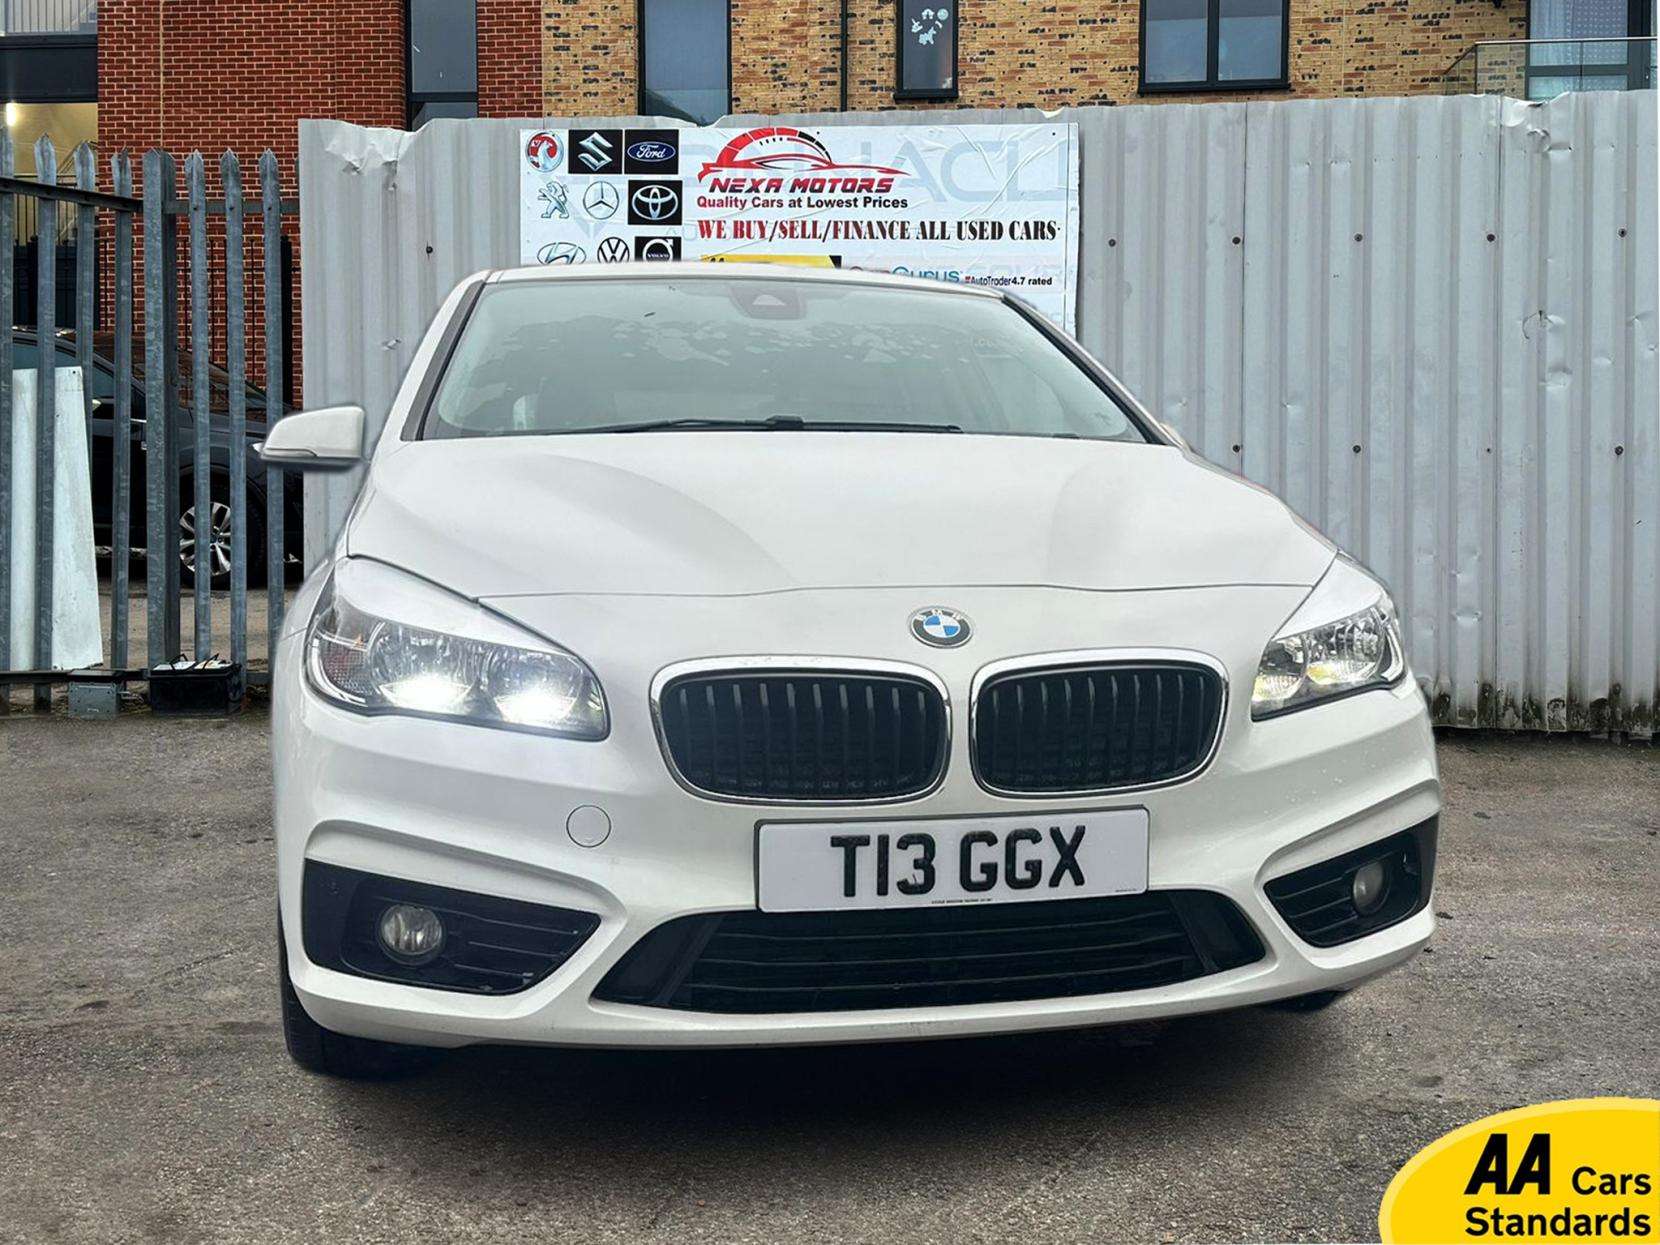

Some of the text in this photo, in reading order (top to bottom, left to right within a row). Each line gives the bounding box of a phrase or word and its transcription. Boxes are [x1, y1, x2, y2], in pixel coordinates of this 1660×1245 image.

[636, 144, 666, 158] Ford
[709, 178, 894, 193] NEXA MOTORS
[697, 196, 908, 210] Quality Cars at Lowest Prices
[697, 219, 727, 239] WE
[915, 220, 951, 240] ALL
[956, 220, 1004, 240] USED
[1008, 220, 1057, 240] CARS
[1028, 277, 1052, 286] rated
[830, 824, 1086, 898] T13 GGX
